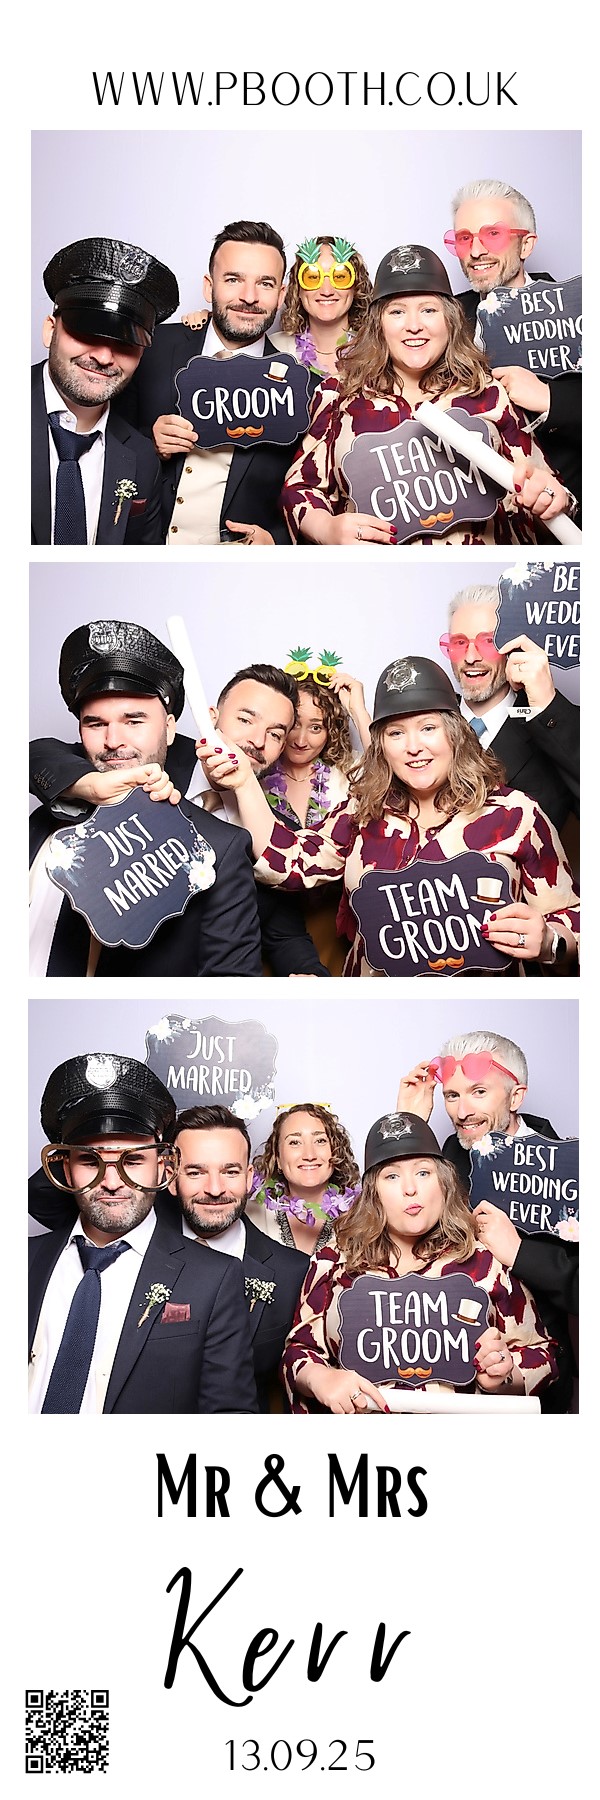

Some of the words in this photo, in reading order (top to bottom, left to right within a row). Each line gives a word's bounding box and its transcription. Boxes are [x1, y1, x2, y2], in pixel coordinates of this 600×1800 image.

[520, 287, 564, 315] BEST
[527, 345, 576, 370] EVER
[191, 386, 295, 425] GROOM
[369, 435, 456, 483] TEAM
[370, 461, 487, 524] GROOM
[544, 634, 580, 658] EVE
[91, 813, 154, 867] JUST
[103, 838, 190, 916] MARRIED
[378, 873, 470, 922] TEAM
[379, 909, 494, 964] GROOM
[186, 1030, 237, 1064] JUST
[166, 1065, 252, 1096] MARRIED
[513, 1143, 559, 1172] BEST
[492, 1170, 578, 1201] WEDDING
[509, 1201, 554, 1232] EVER
[368, 1290, 449, 1328] TEAM
[357, 1327, 470, 1369] GROOM
